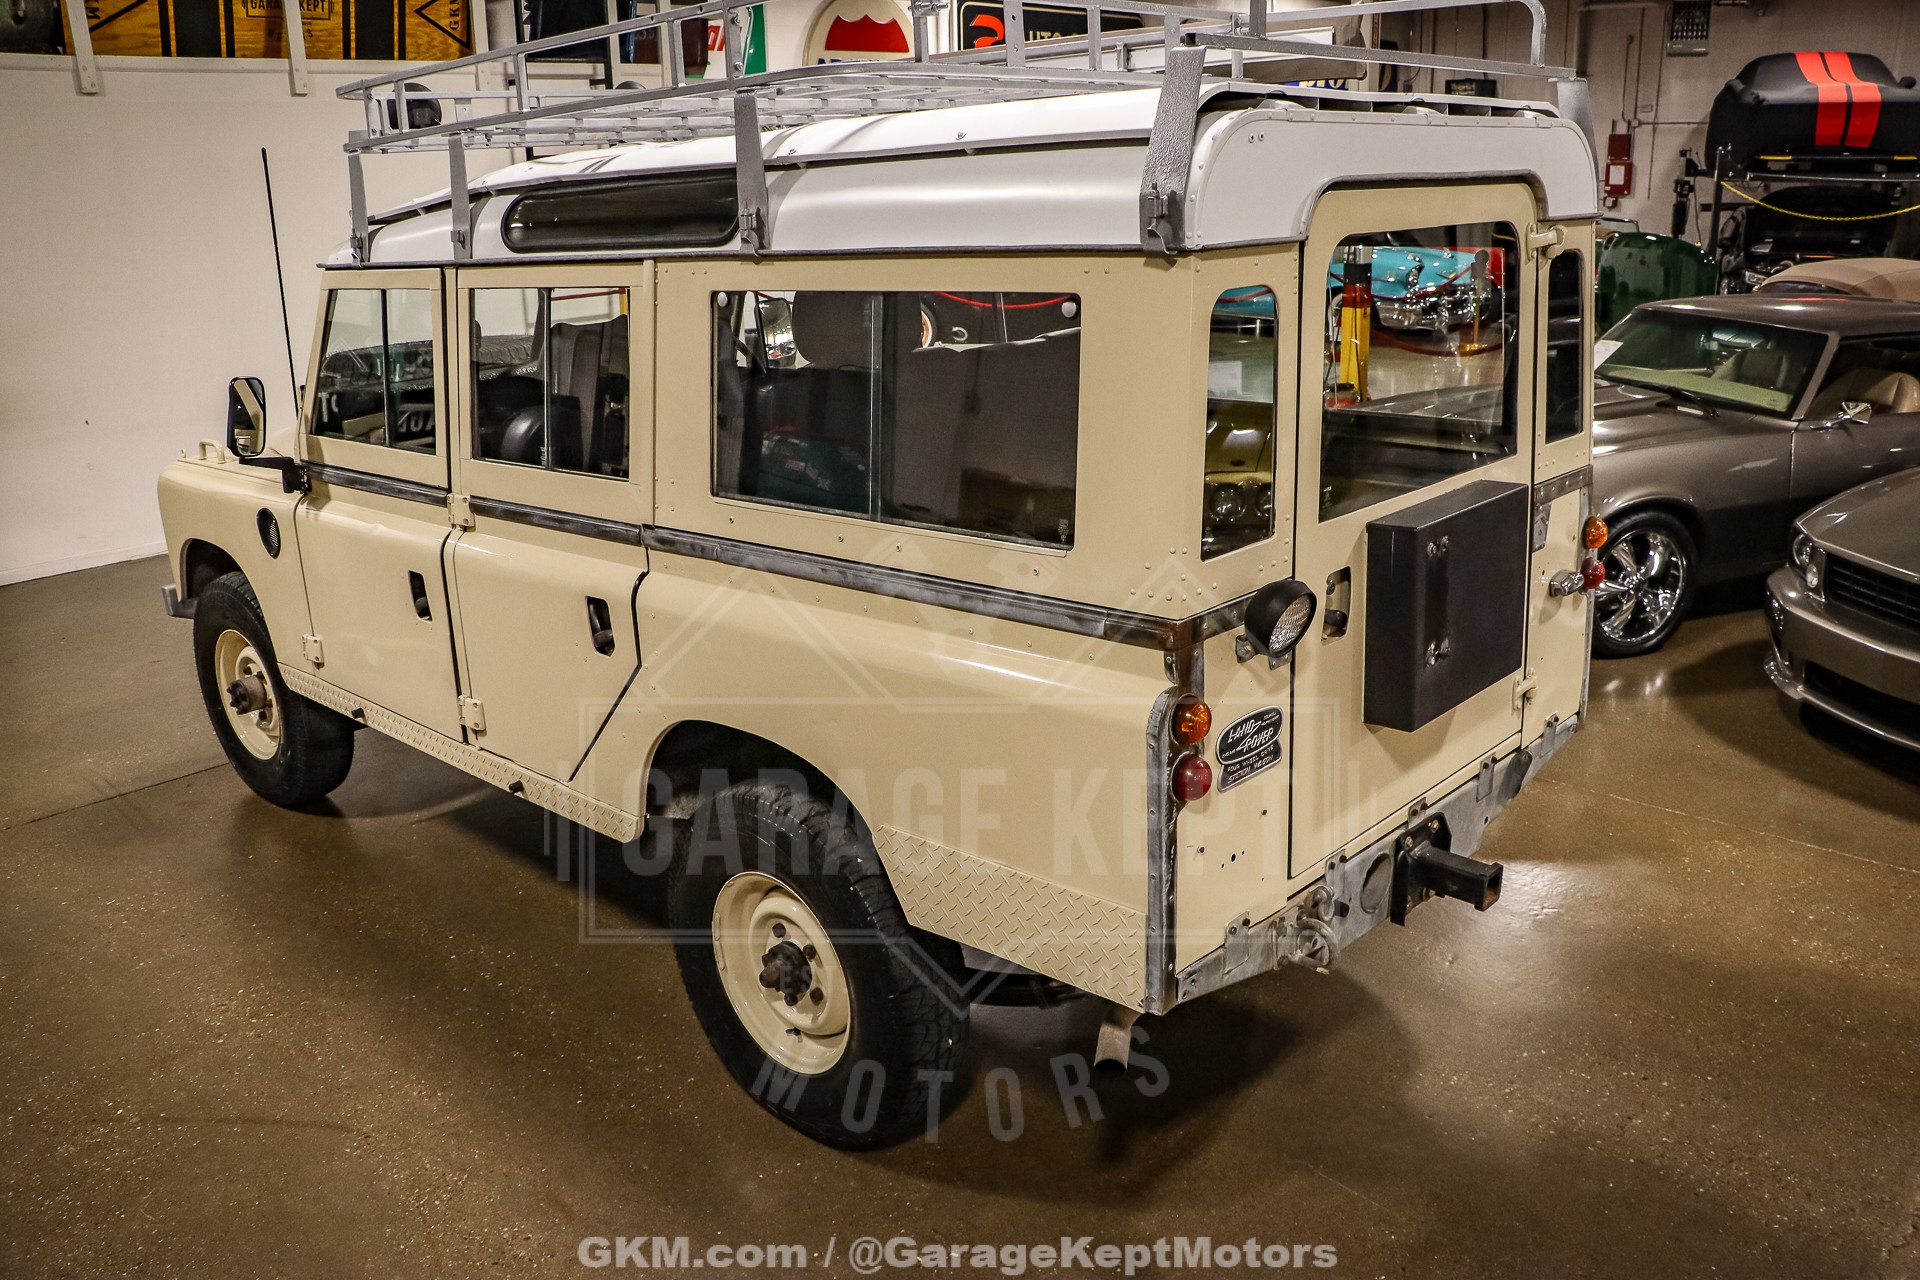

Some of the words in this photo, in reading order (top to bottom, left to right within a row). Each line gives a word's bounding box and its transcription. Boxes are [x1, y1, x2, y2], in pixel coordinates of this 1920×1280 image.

[1228, 720, 1256, 743] LAND
[1243, 727, 1274, 752] ROVER
[1228, 766, 1251, 784] STATION
